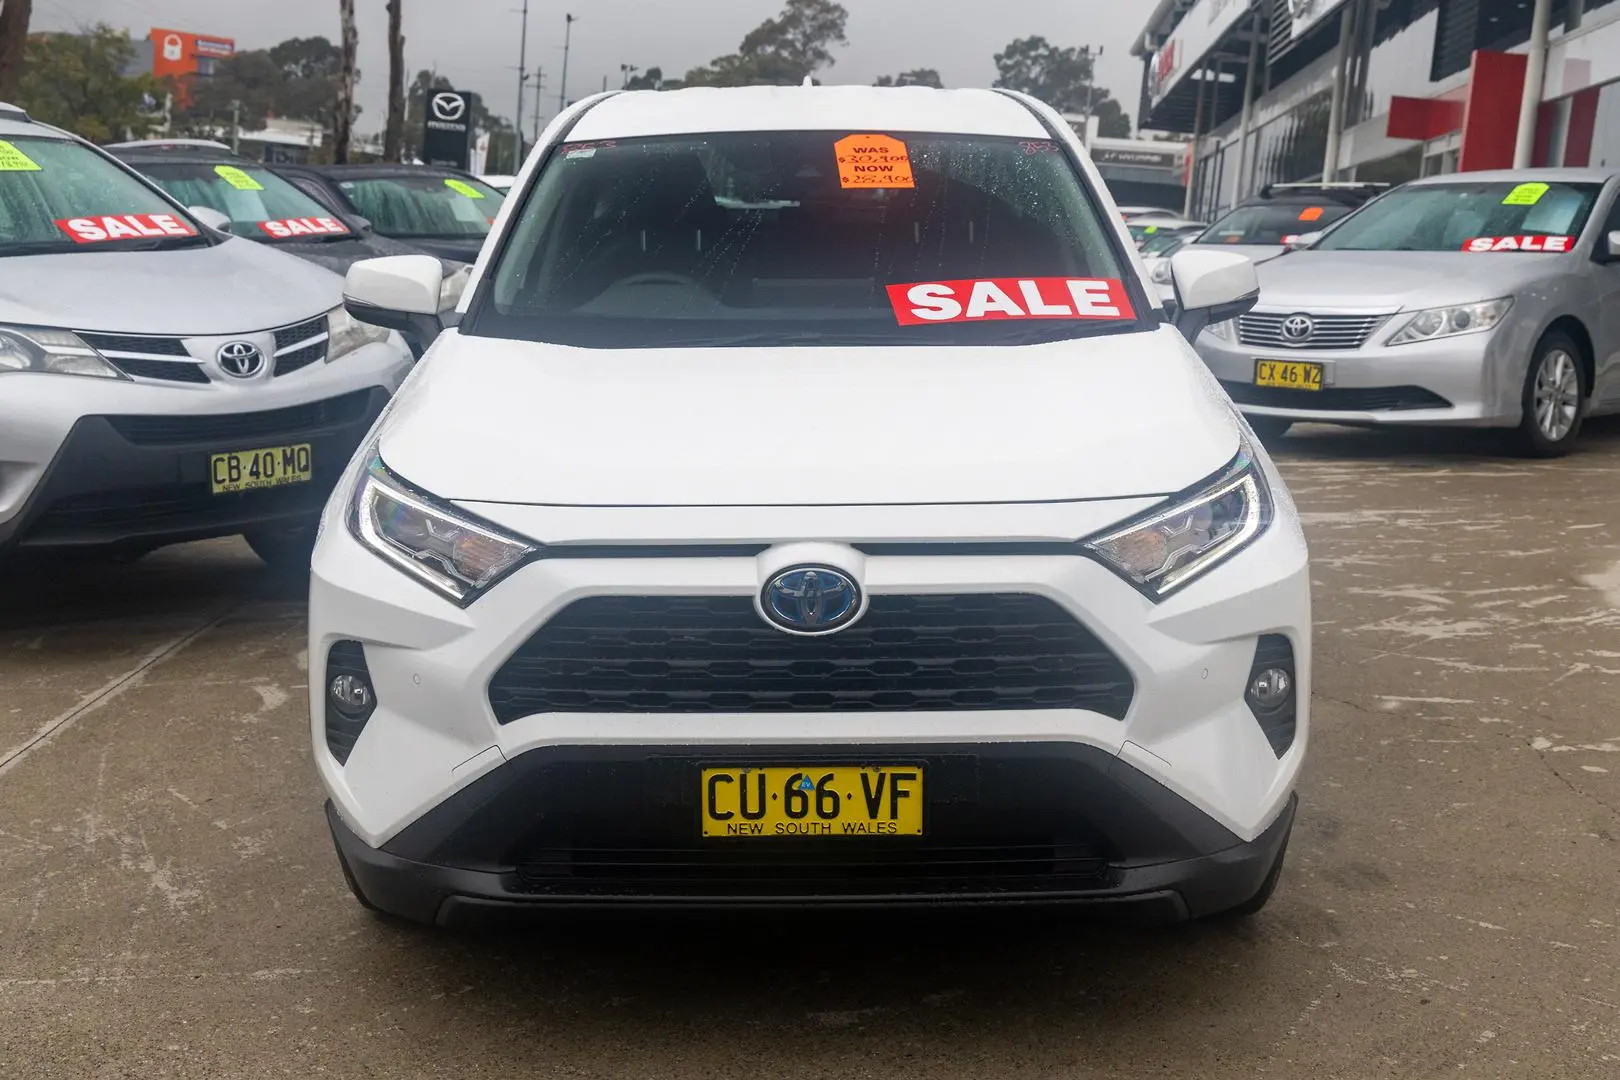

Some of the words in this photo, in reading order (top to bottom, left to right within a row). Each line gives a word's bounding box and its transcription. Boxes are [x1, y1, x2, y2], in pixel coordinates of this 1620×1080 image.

[67, 213, 189, 241] SALE
[264, 217, 341, 236] SALE
[1468, 236, 1569, 251] SALE
[907, 280, 1121, 320] SALE
[727, 823, 764, 834] NEW
[775, 823, 831, 834] SOUTH
[842, 823, 897, 834] WALES
